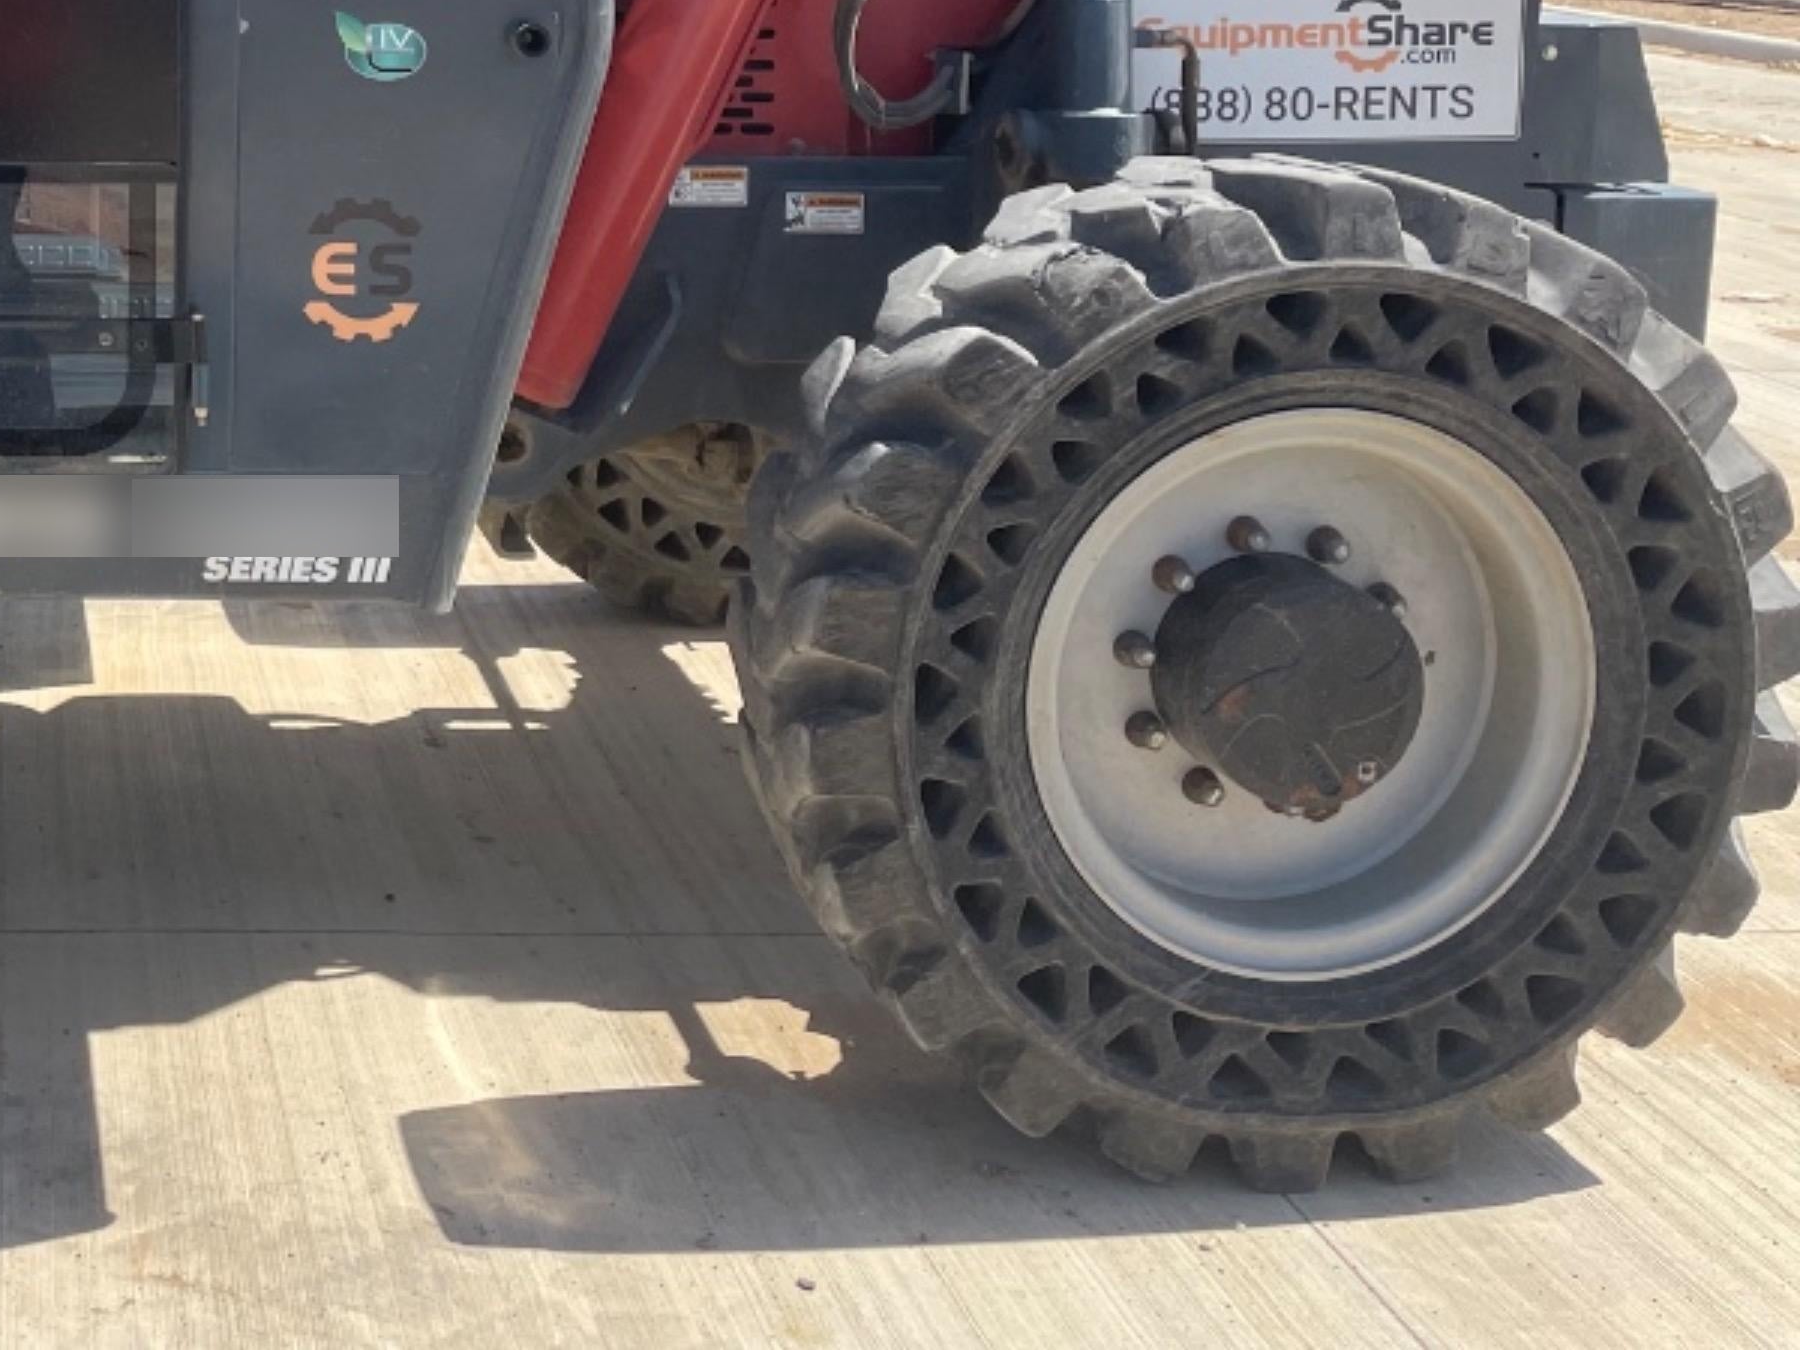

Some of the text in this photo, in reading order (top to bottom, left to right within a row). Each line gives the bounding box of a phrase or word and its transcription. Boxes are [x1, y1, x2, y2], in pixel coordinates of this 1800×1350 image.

[1400, 48, 1456, 64] .com
[1264, 84, 1474, 122] 80-RENTS
[311, 242, 413, 296] ES
[203, 556, 391, 584] SERIES III
